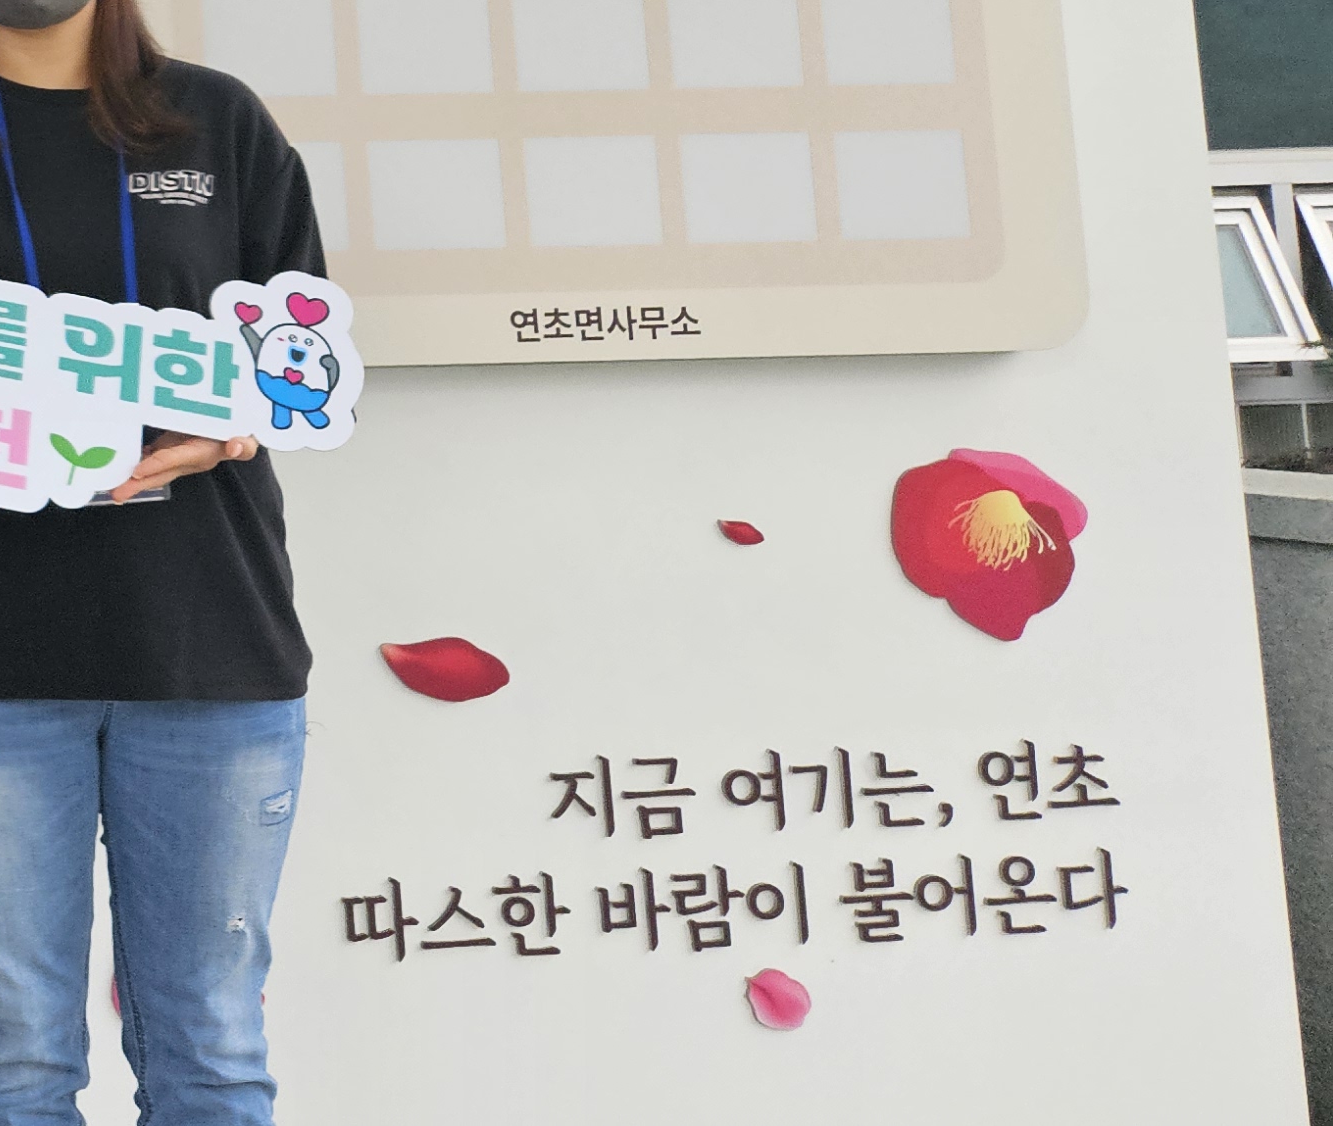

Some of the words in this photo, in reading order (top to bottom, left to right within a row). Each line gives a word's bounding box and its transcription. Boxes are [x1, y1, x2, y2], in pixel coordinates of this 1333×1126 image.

[57, 313, 241, 422] 위한
[510, 306, 702, 345] 연초면사무소
[549, 755, 695, 839] 지금
[720, 745, 955, 833] 여기는,
[976, 738, 1121, 822] 연초
[341, 872, 571, 963] 따스한
[594, 860, 811, 953] 바람이
[839, 846, 1129, 944] 불어온다
